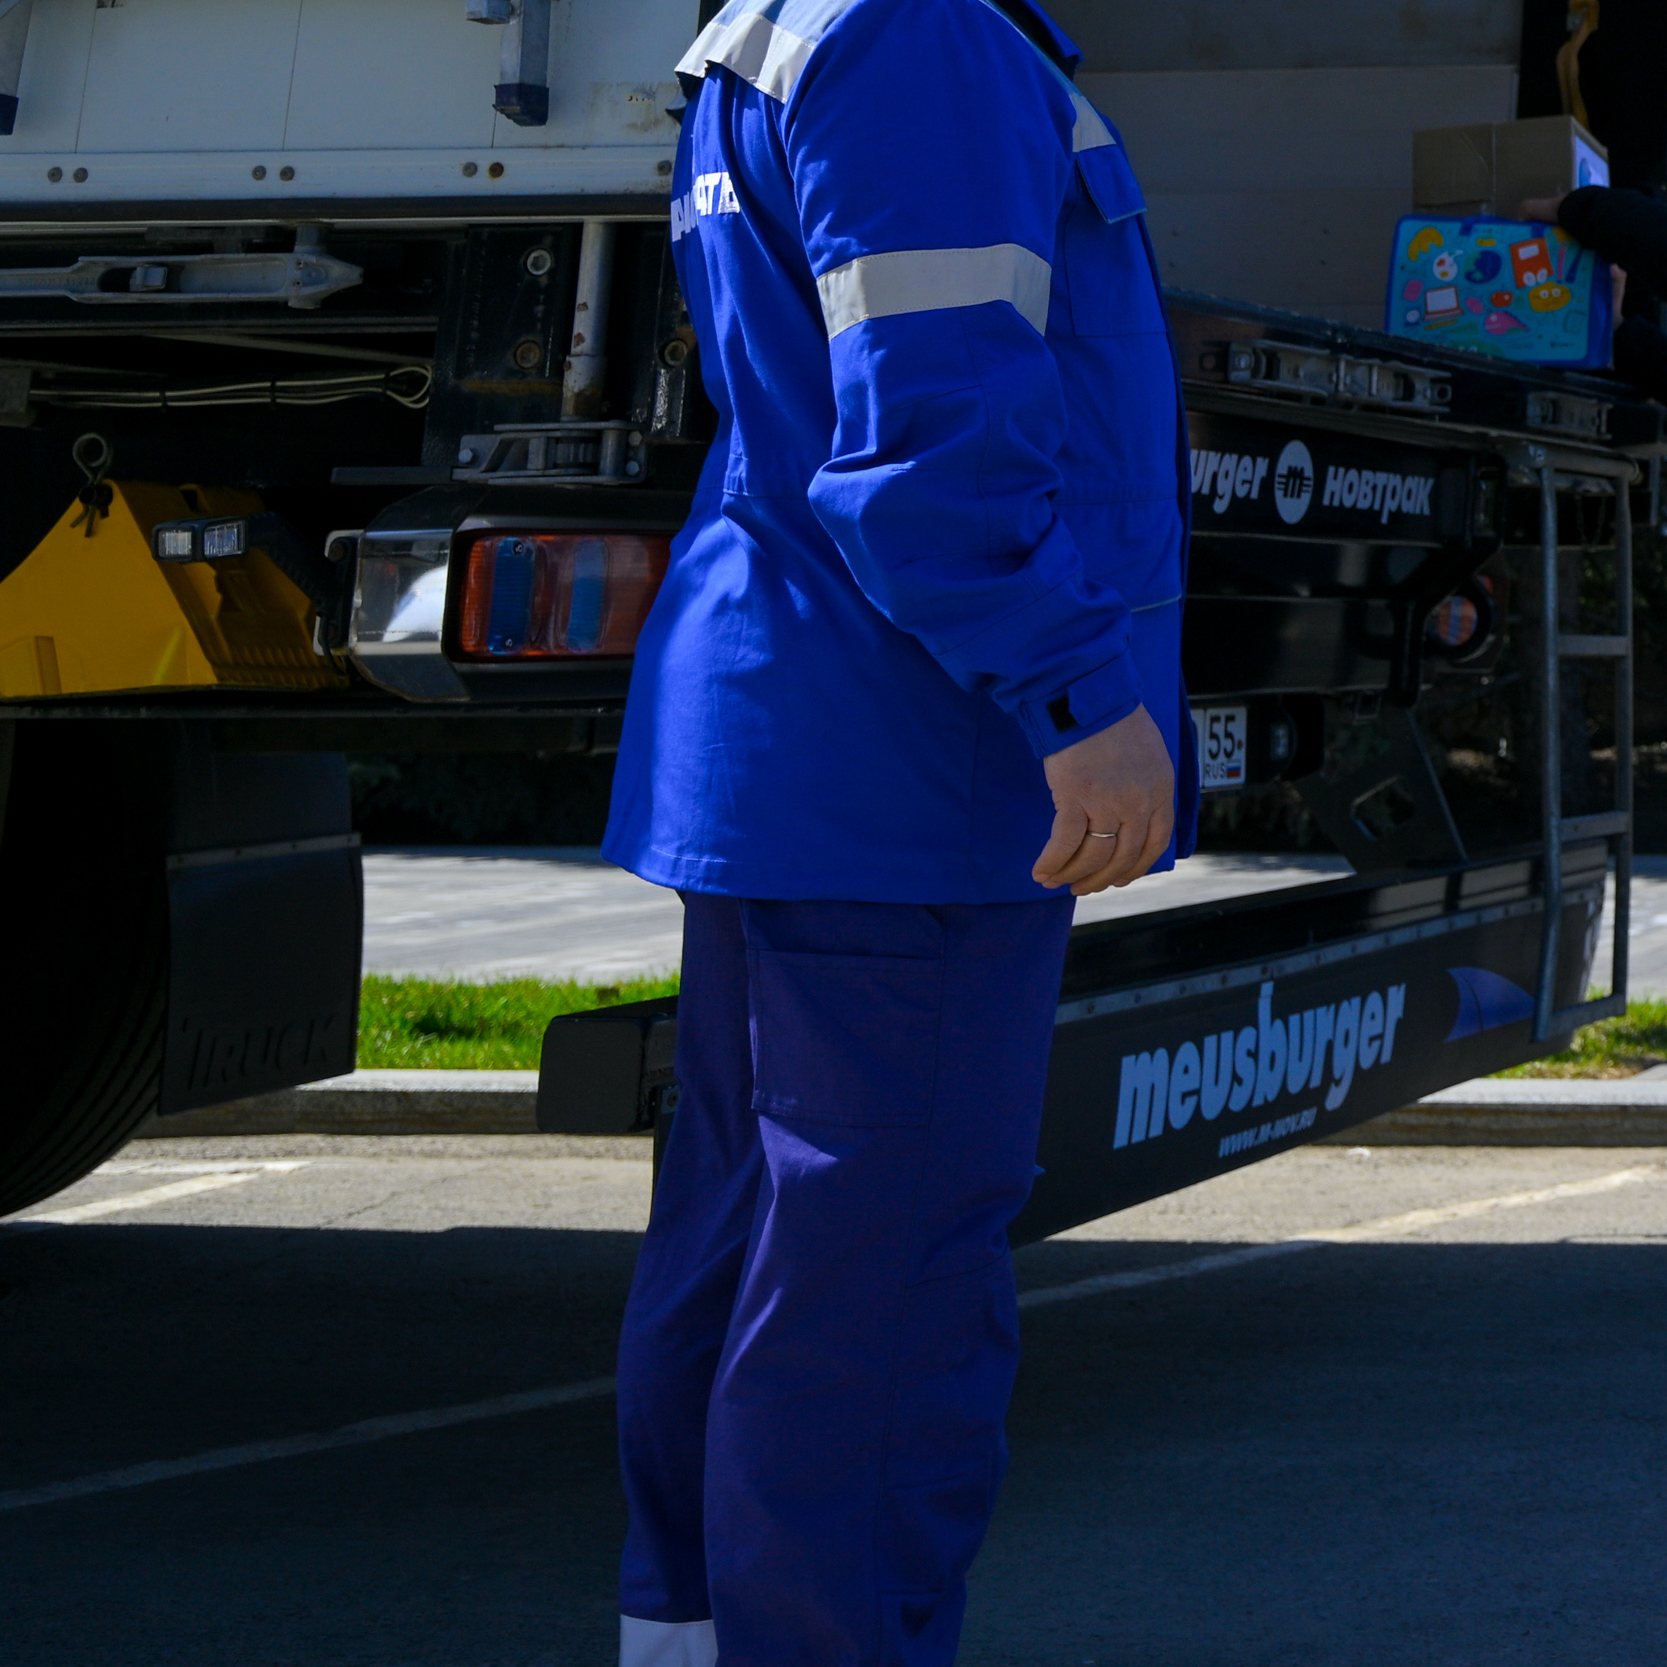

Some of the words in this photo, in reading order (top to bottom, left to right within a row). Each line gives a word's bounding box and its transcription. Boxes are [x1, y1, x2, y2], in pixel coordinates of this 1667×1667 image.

[1208, 715, 1236, 760] 55
[1205, 763, 1226, 779] RUS
[179, 1012, 338, 1091] TRUCK
[1112, 981, 1407, 1150] meusburger
